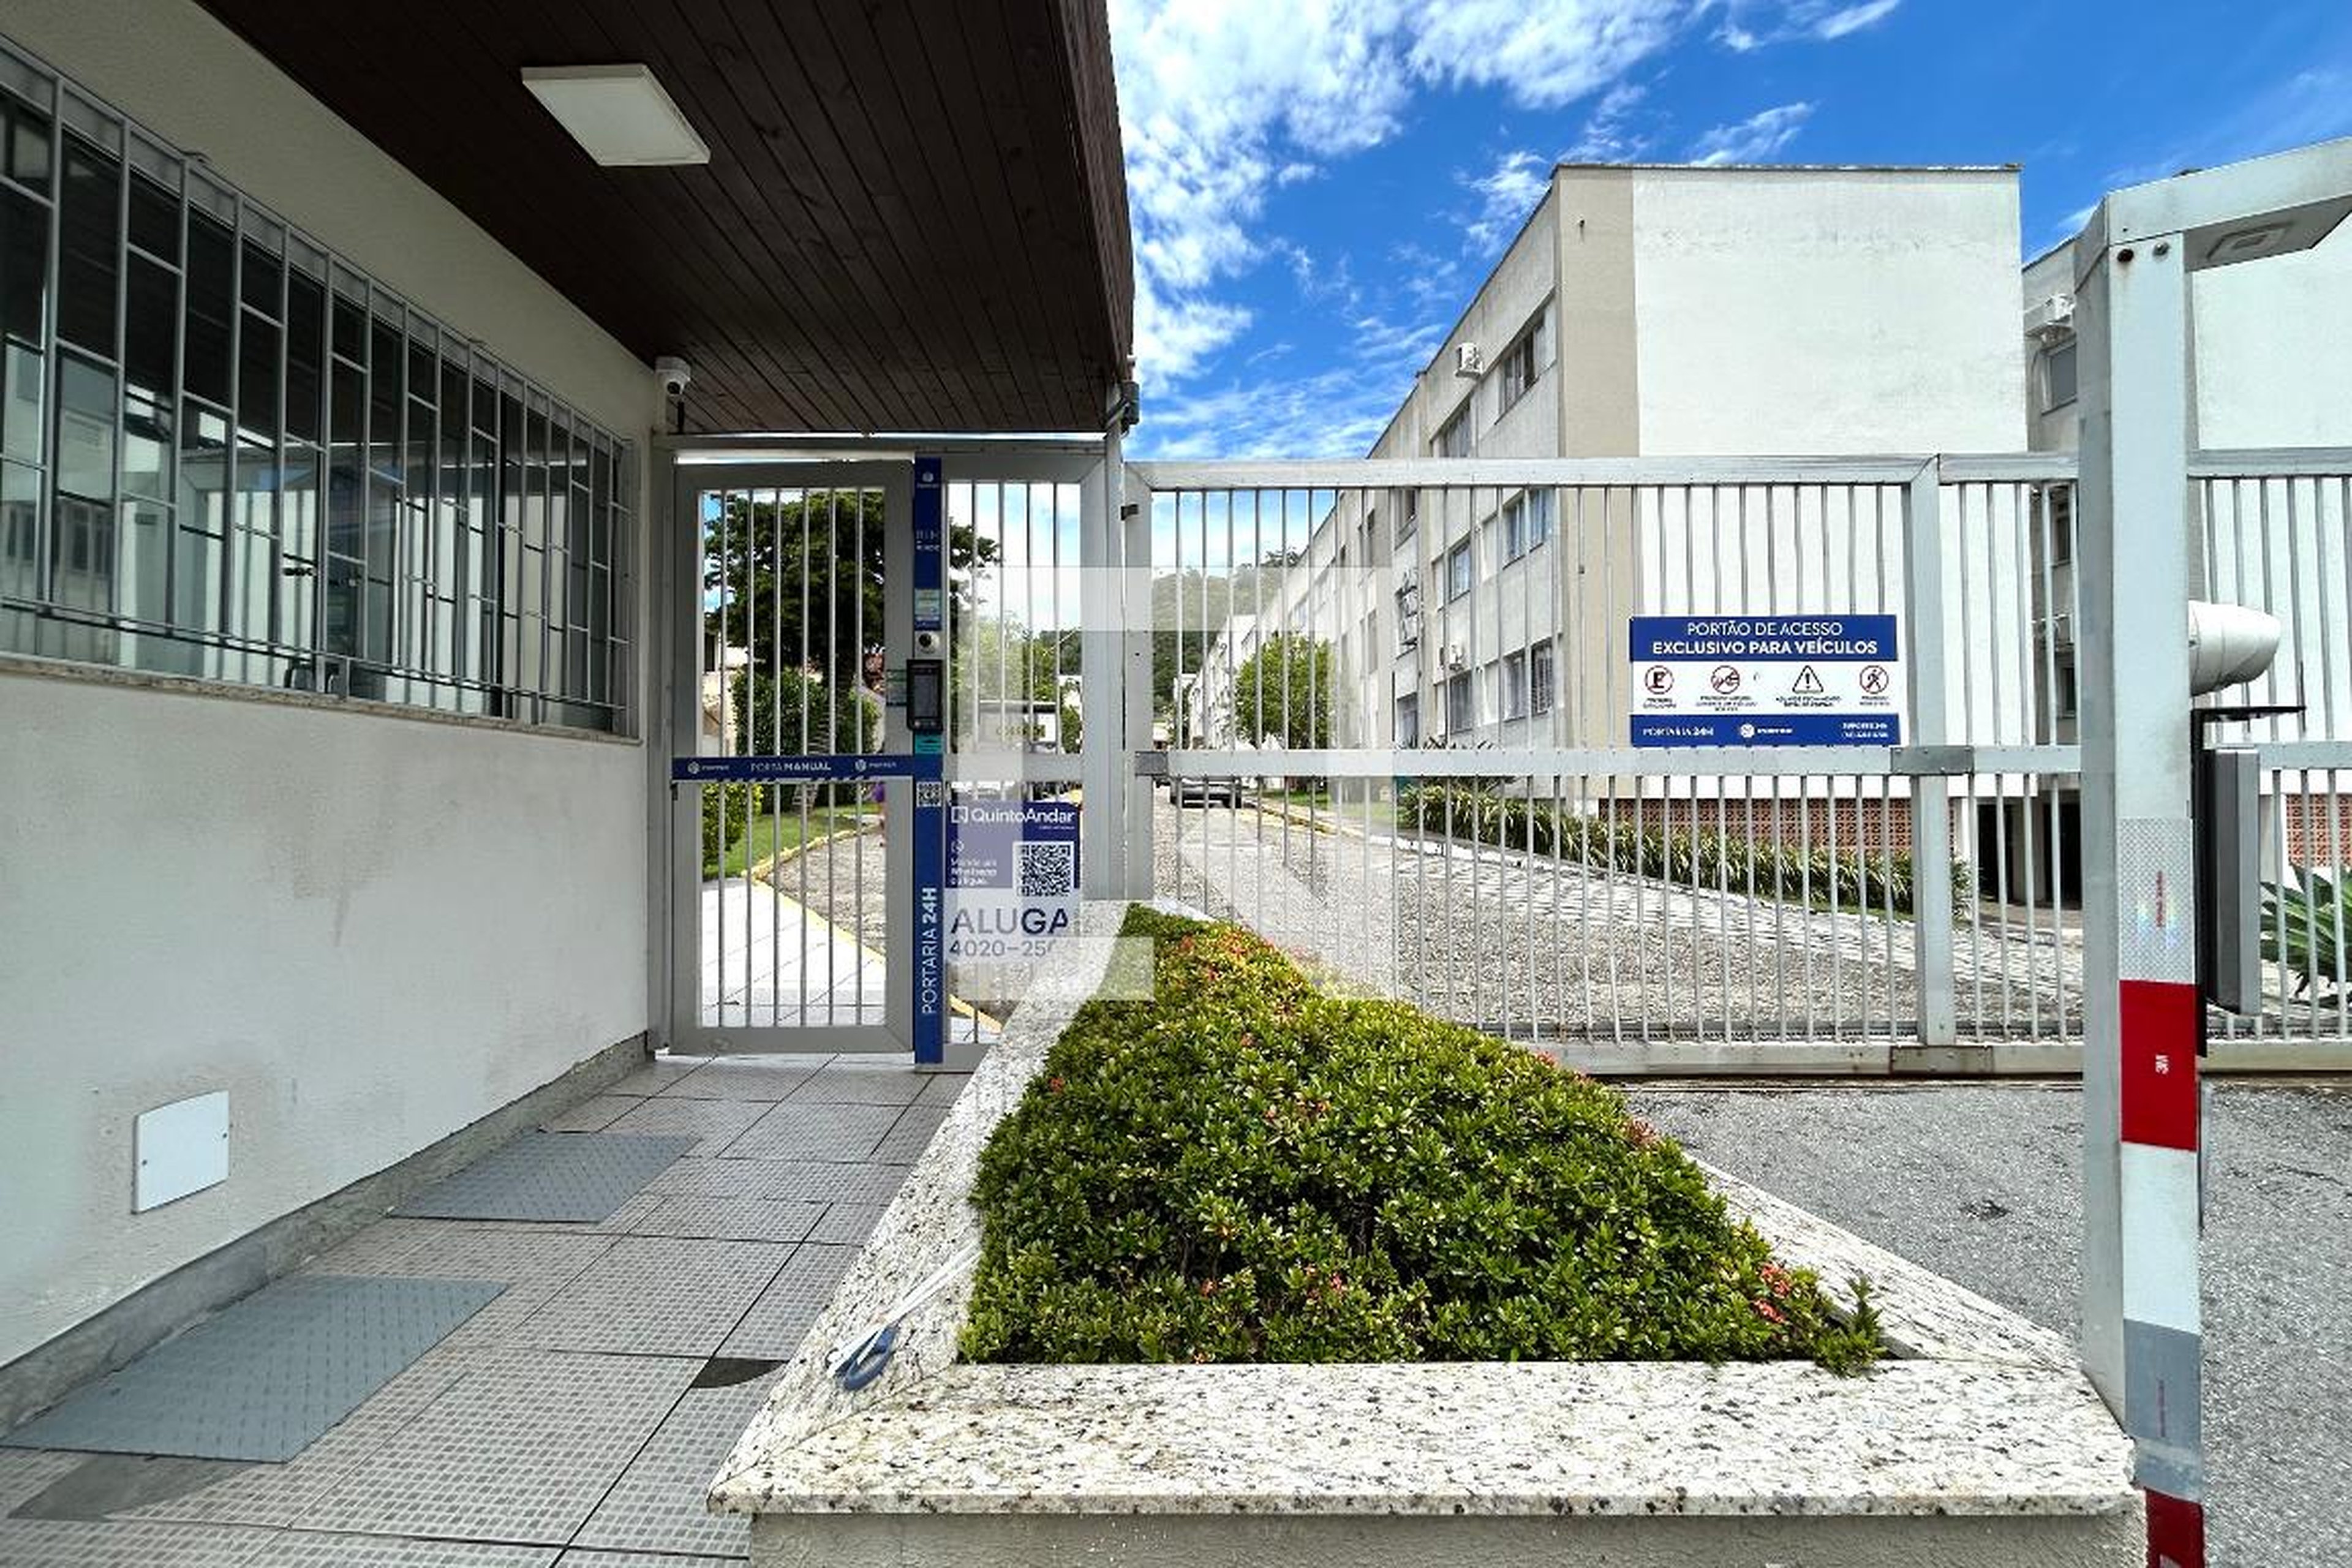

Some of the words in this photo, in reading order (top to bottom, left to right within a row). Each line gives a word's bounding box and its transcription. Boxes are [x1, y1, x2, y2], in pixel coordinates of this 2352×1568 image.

[1687, 620, 1751, 636] PORTÃO
[1755, 622, 1776, 636] DE
[1779, 622, 1843, 636] ACESSO
[1653, 641, 1746, 654] EXCLUSIVO
[1749, 641, 1792, 654] PARA
[1795, 636, 1877, 654] VEÍCULOS
[971, 808, 1076, 824] QuintoAndar
[921, 887, 938, 924] 24H
[951, 908, 1069, 935] ALUGA
[921, 927, 938, 1014] PORTARIA
